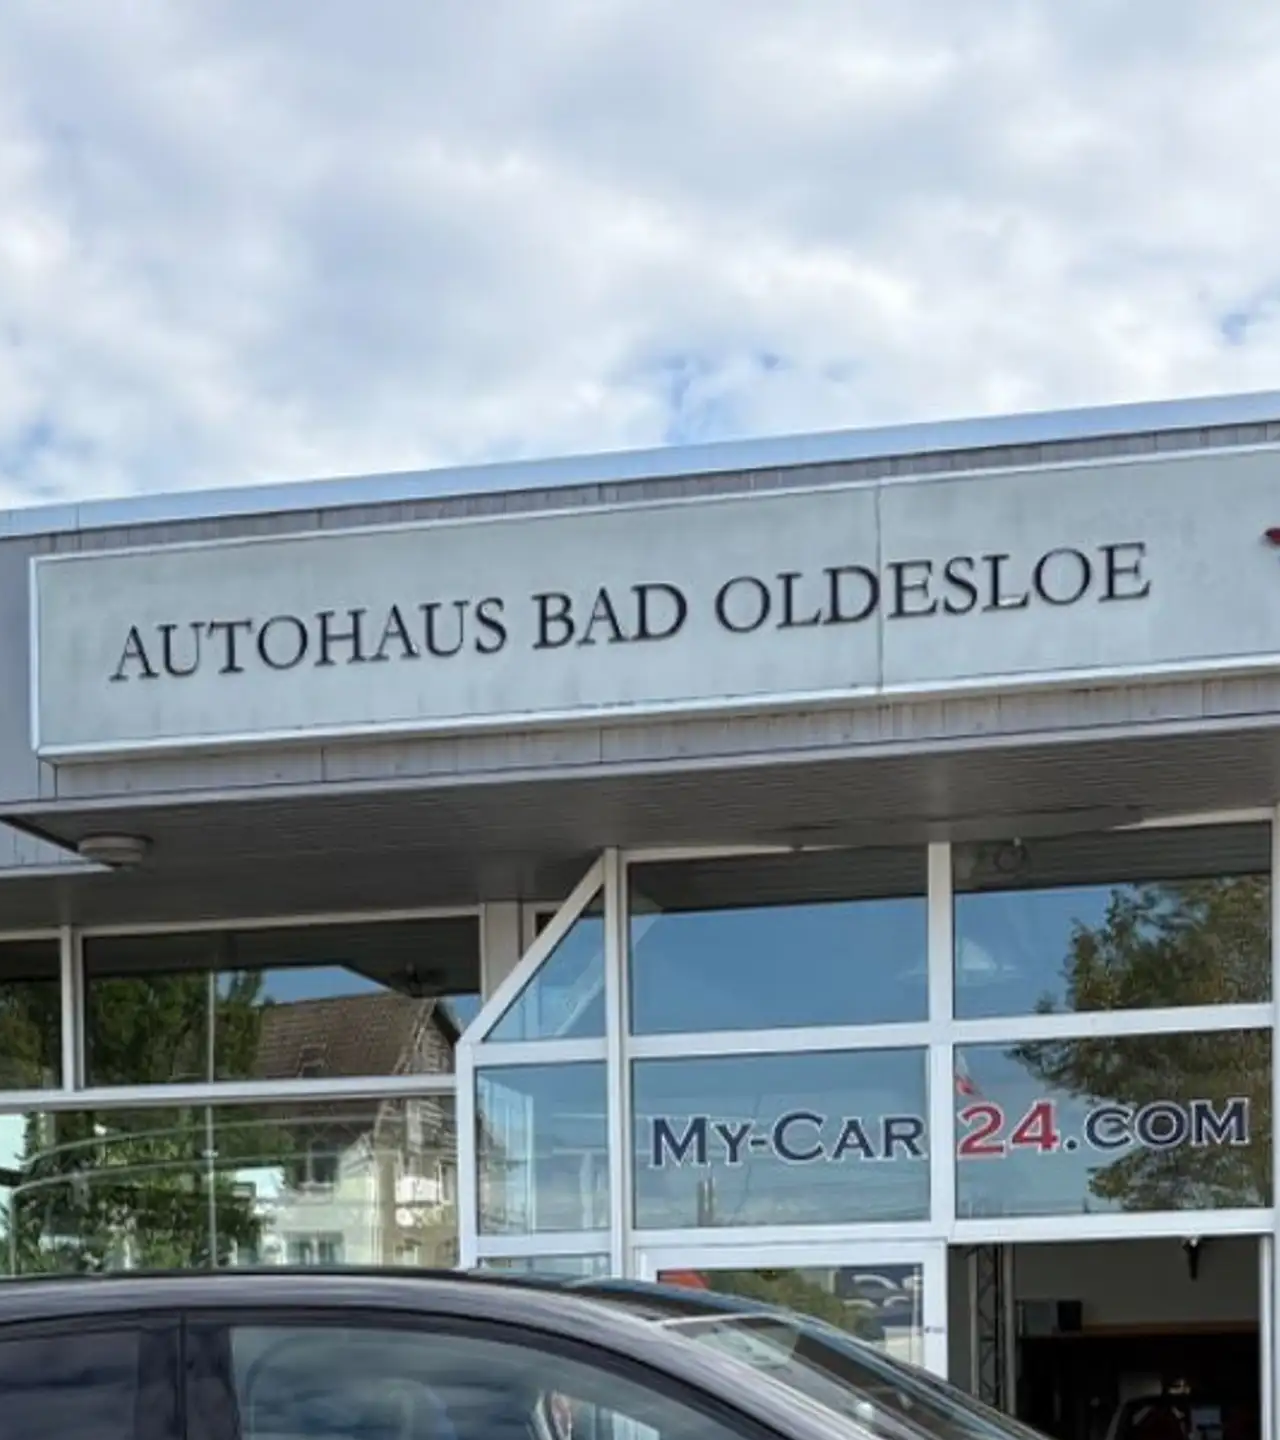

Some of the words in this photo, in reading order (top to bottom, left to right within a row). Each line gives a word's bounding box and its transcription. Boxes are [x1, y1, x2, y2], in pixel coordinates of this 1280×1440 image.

[109, 597, 508, 682] AUTOHAUS
[531, 582, 689, 650] BAD
[714, 541, 1152, 634] OLDESLOE
